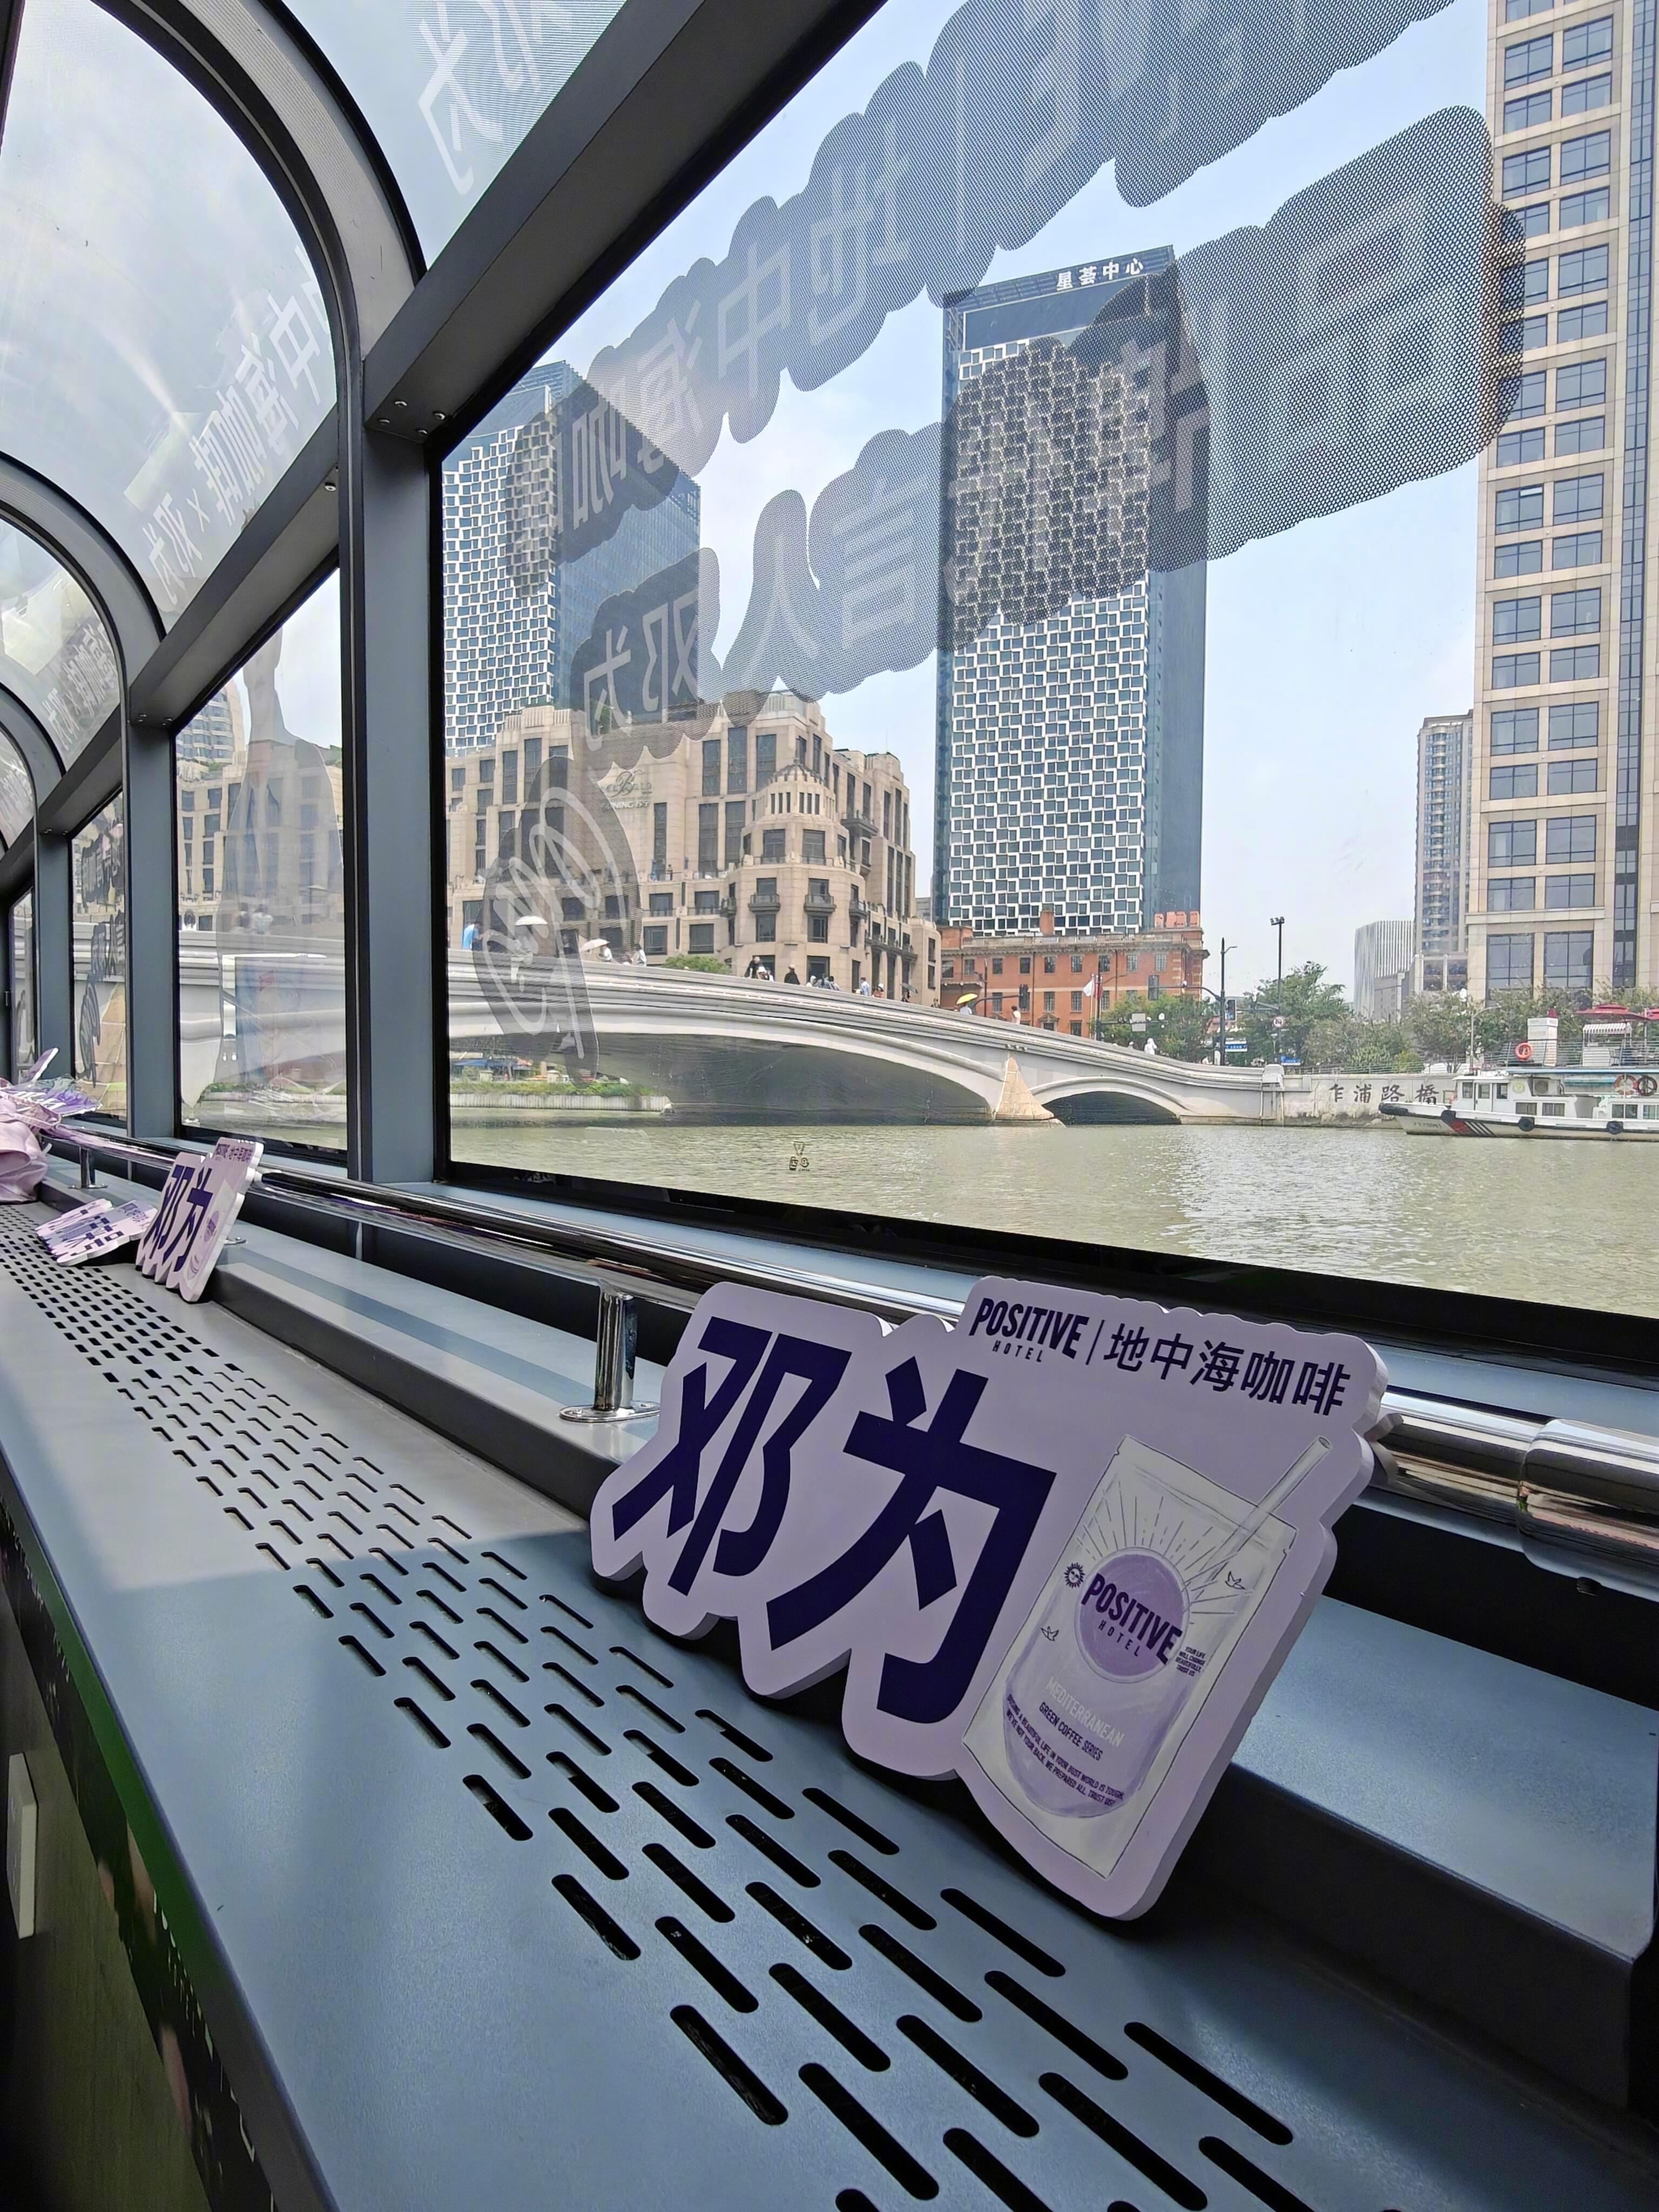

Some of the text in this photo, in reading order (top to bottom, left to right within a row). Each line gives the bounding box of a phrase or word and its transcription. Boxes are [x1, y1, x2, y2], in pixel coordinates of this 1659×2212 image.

[1056, 258, 1144, 292] 星荟中心
[1330, 1083, 1439, 1104] 乍浦路橋
[143, 1164, 213, 1272] 邓为
[969, 1298, 1089, 1359] POSITIVE
[992, 1340, 1044, 1363] HOTEL
[1104, 1322, 1352, 1416] 地中海咖啡
[612, 1316, 1056, 1724] 邓为
[1081, 1573, 1183, 1665] POSITIVE
[1098, 1620, 1139, 1657] HOTEL
[1039, 1702, 1103, 1761] GREEN COFFEE SERIES
[1046, 1676, 1124, 1747] MEDITERRANEAN
[1040, 1741, 1051, 1755] LIFE
[1098, 1784, 1106, 1792] IS
